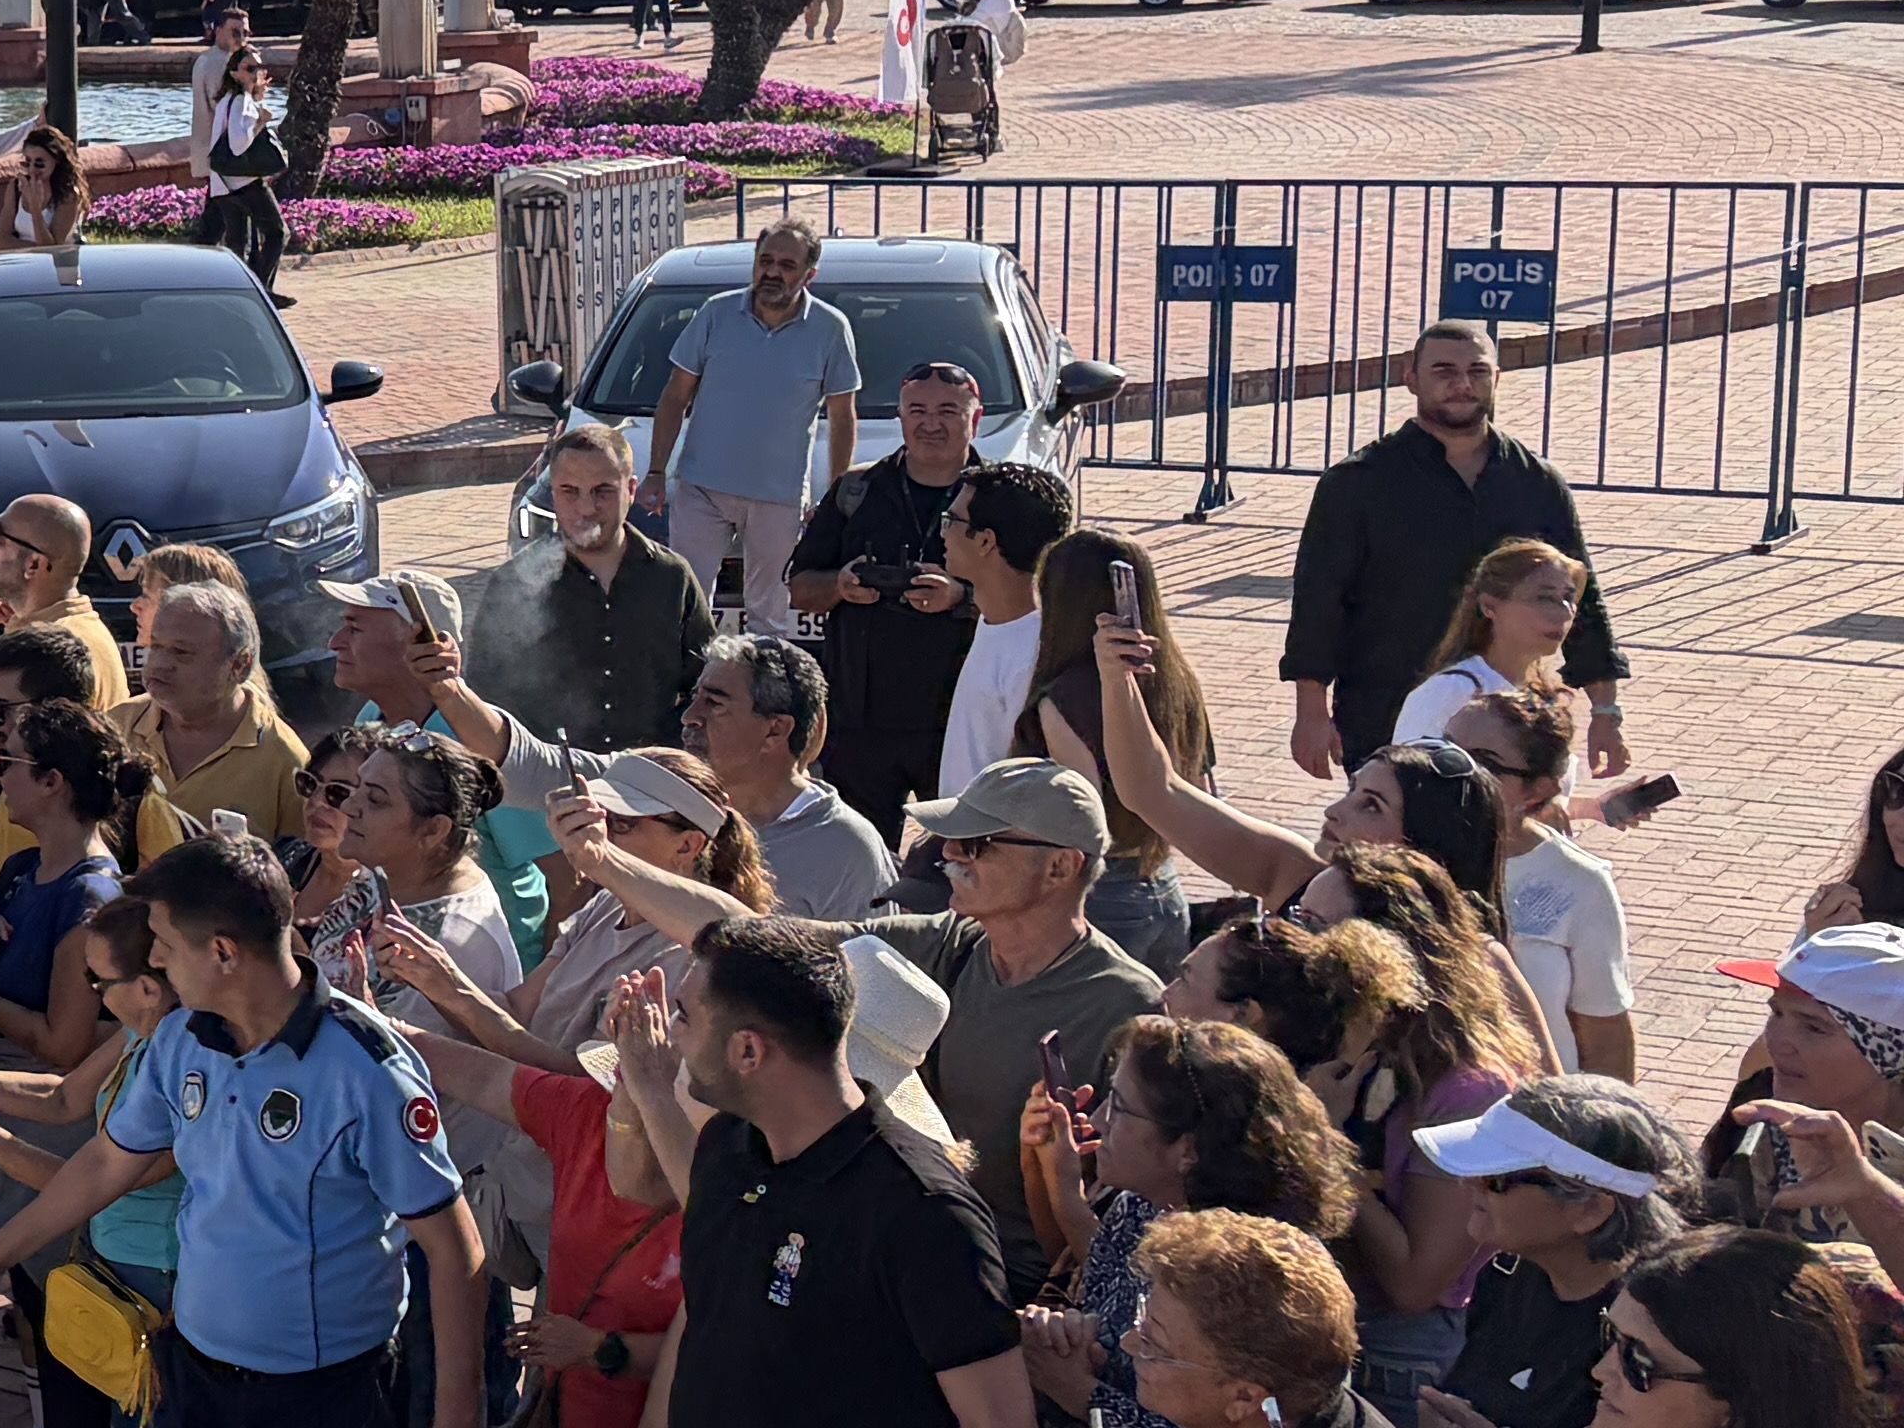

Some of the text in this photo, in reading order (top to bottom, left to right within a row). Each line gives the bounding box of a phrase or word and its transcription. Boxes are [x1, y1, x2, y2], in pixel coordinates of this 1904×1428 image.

[1249, 263, 1280, 287] 07
[1454, 258, 1545, 285] POLİS
[1480, 290, 1514, 311] 07
